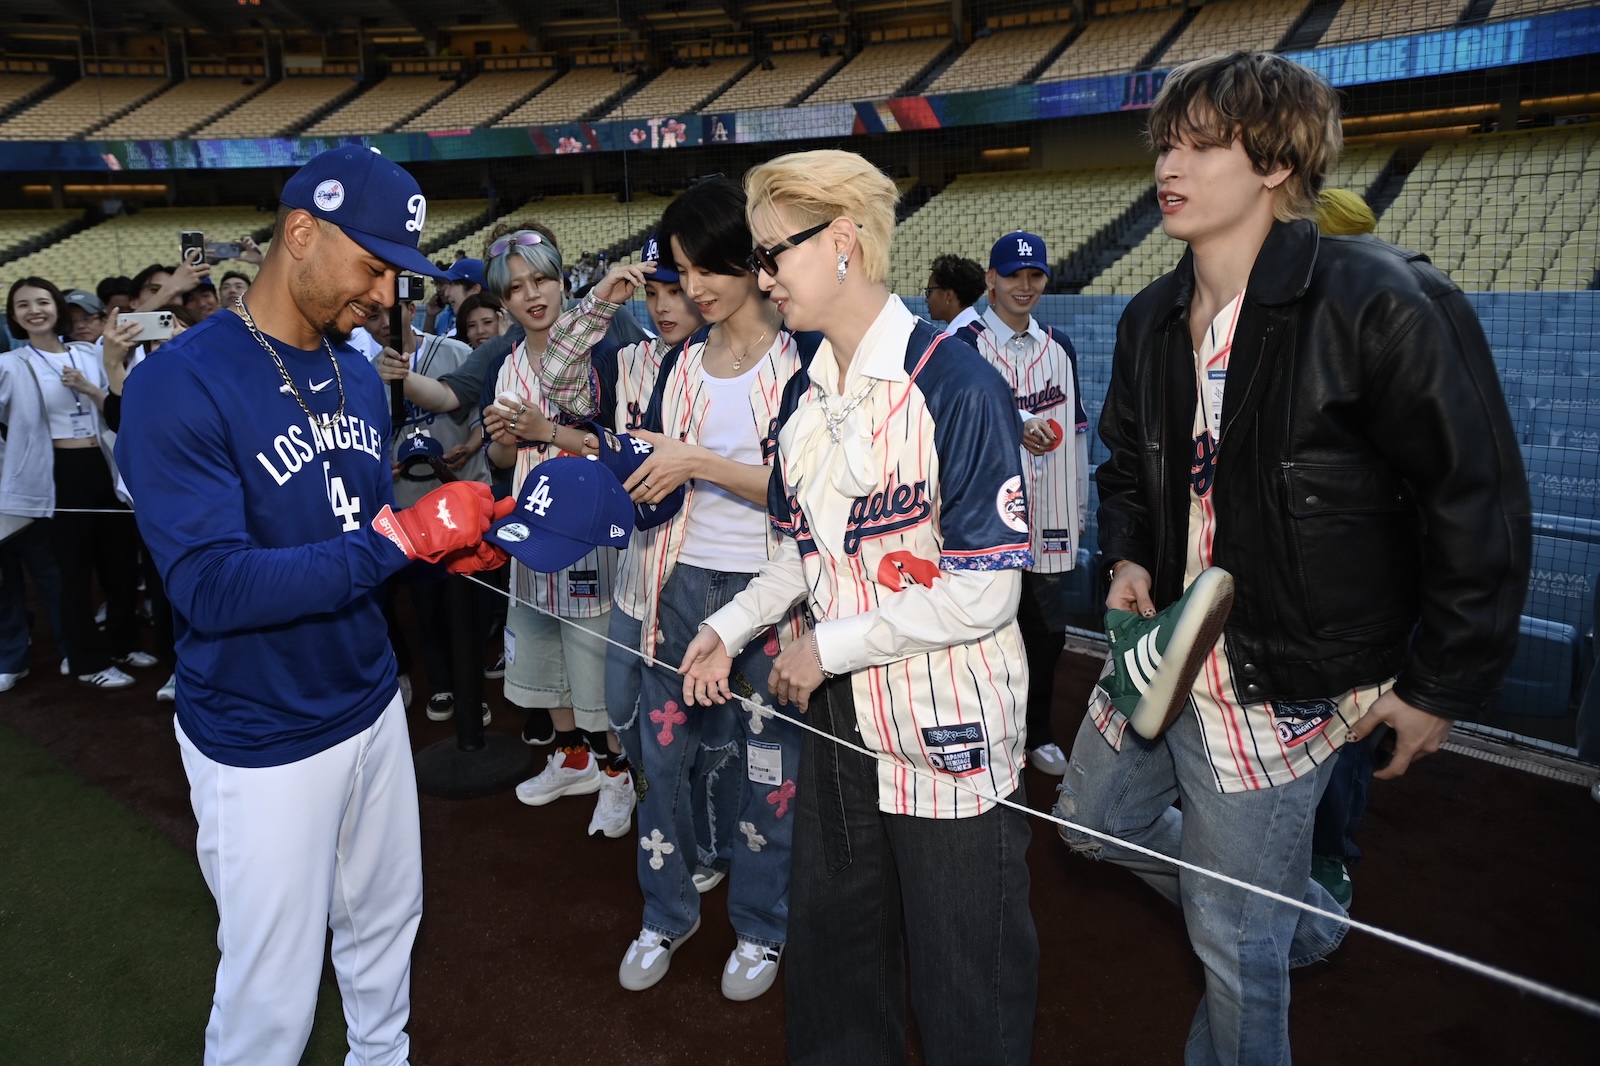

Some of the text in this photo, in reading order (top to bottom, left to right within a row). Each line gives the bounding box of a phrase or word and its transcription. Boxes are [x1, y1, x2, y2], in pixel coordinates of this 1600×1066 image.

[1415, 20, 1531, 76] NIGHT
[1016, 238, 1033, 256] LA
[1015, 377, 1068, 415] ngeles
[256, 413, 381, 486] LOS ANGELE
[524, 475, 553, 517] LA
[928, 727, 979, 743] ドジャース
[944, 751, 971, 761] JAPANESE
